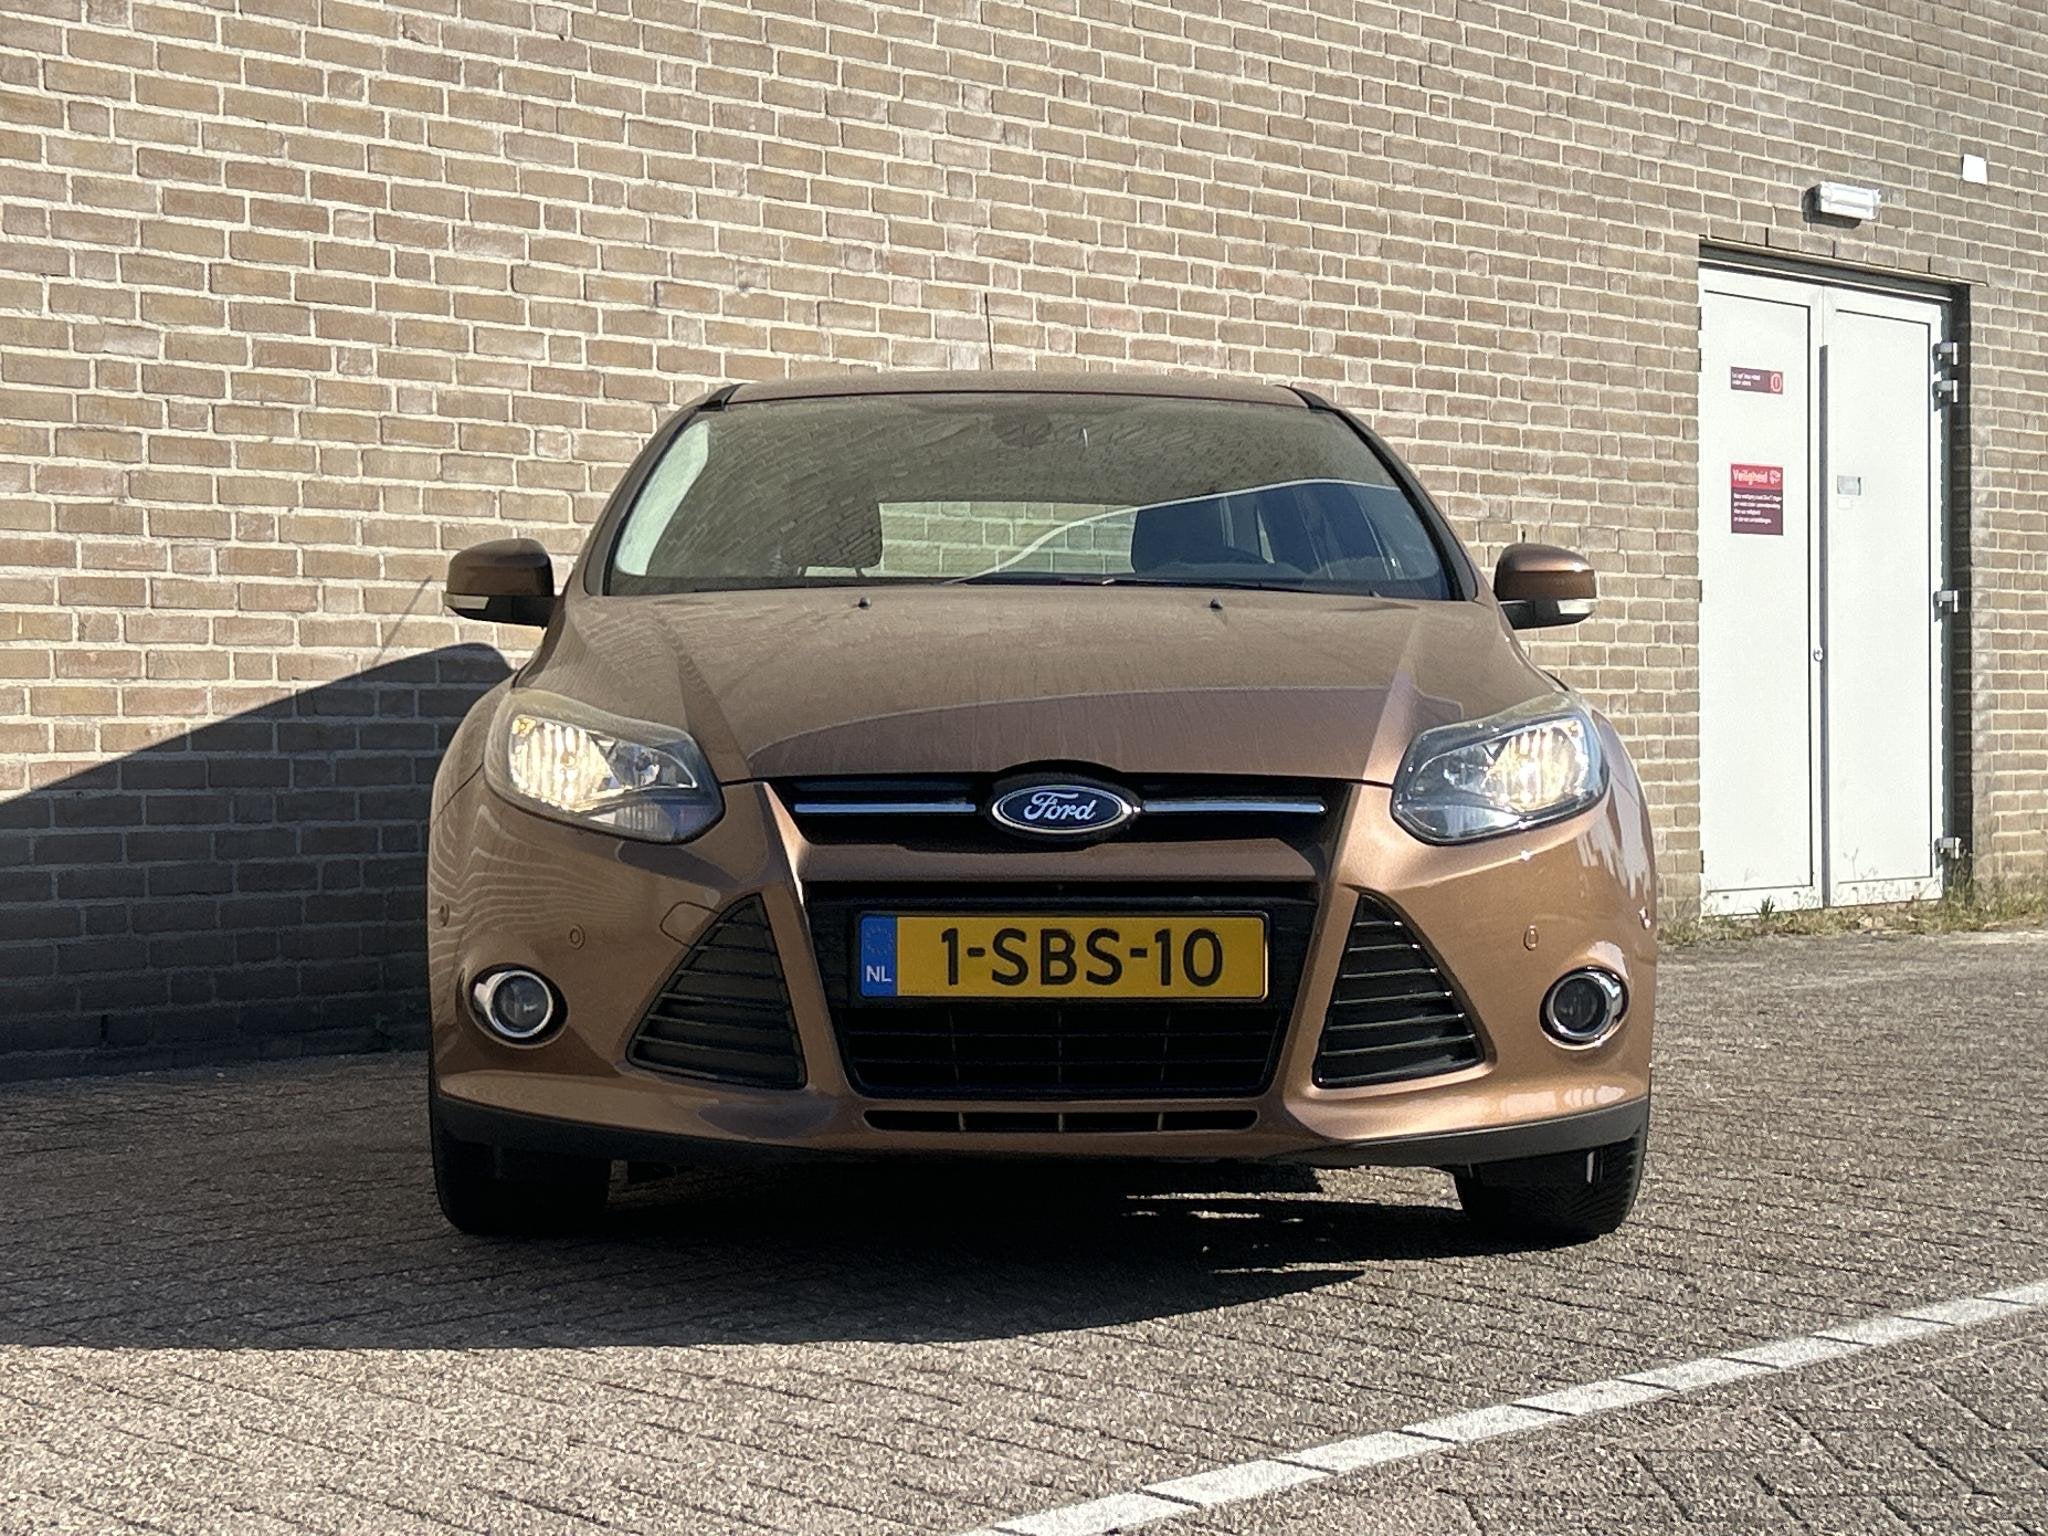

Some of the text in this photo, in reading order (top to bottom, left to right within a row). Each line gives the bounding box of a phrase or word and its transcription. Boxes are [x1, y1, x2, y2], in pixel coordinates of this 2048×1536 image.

[1023, 791, 1097, 820] Ford
[941, 928, 1223, 986] 1-SBS-10
[866, 965, 892, 983] NL
